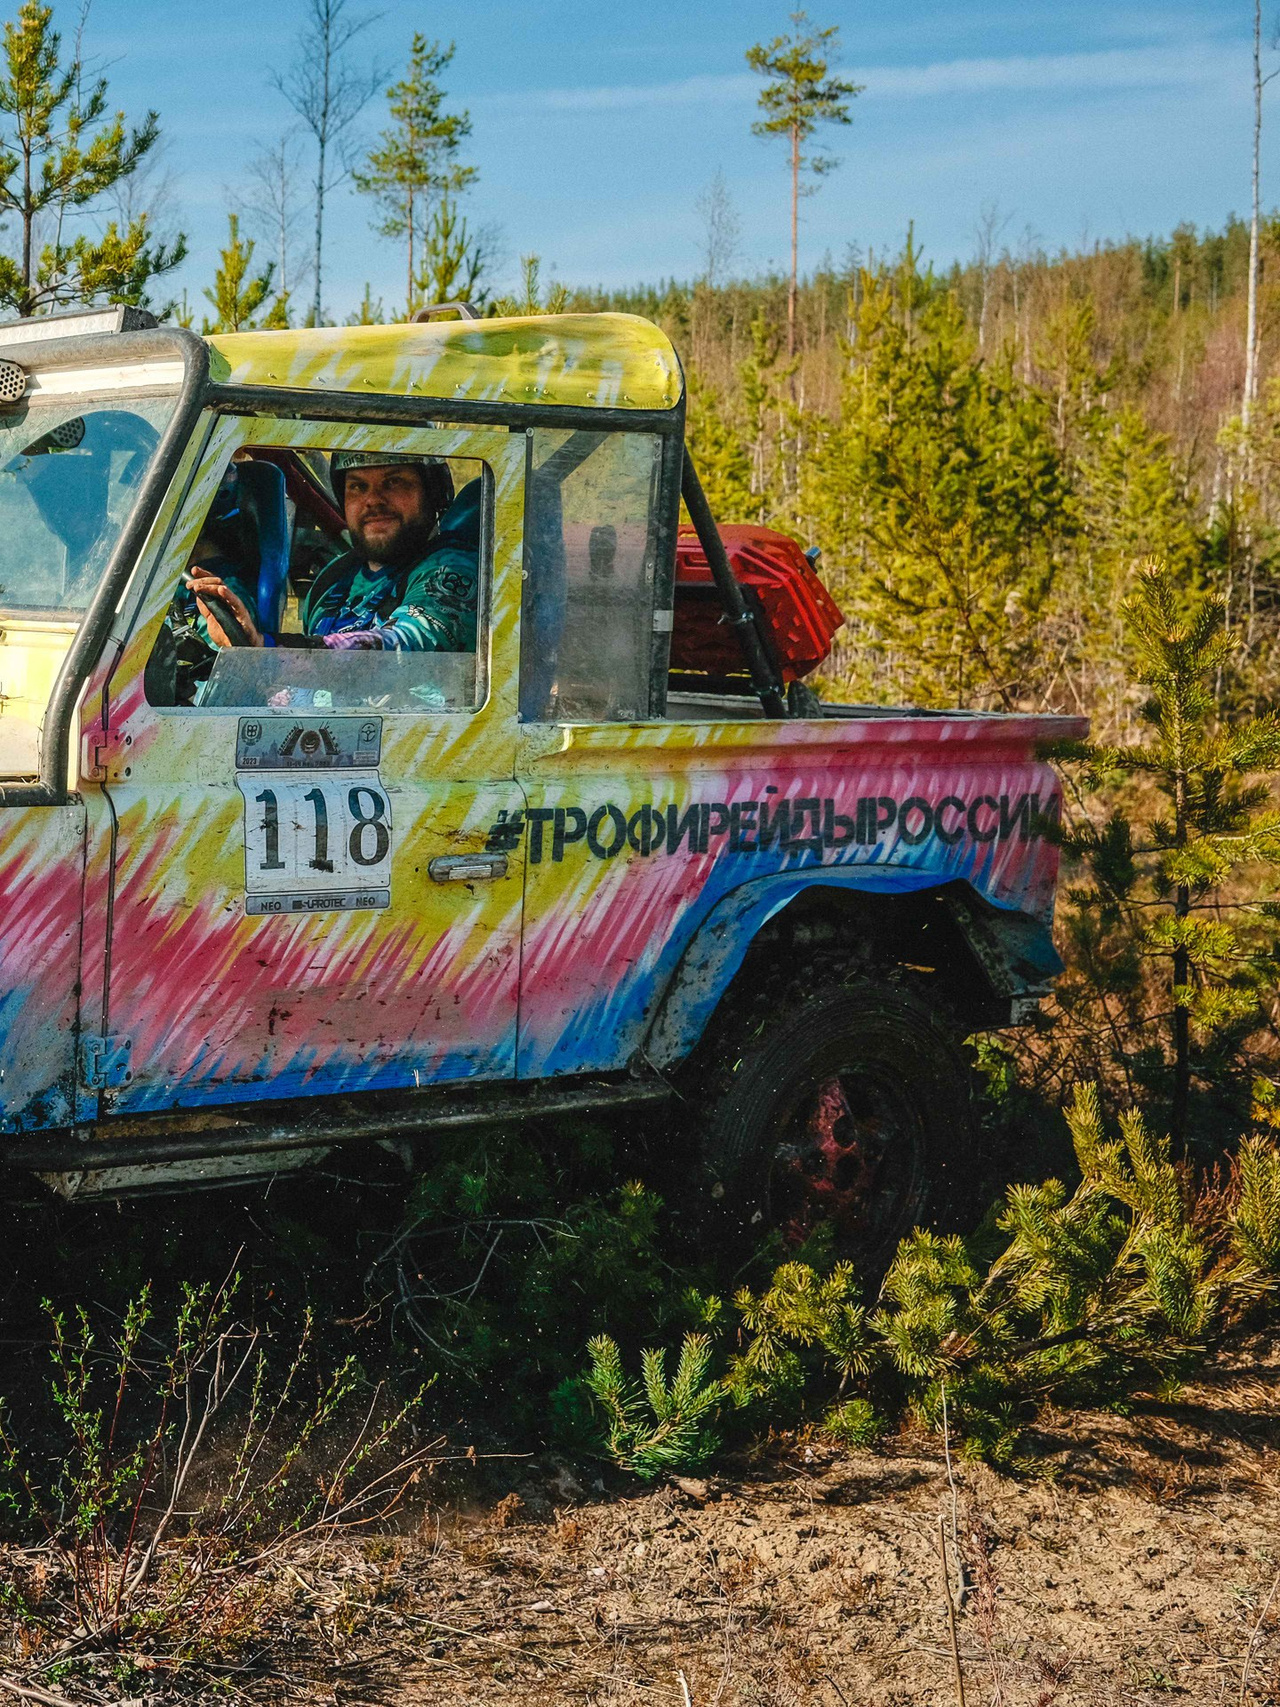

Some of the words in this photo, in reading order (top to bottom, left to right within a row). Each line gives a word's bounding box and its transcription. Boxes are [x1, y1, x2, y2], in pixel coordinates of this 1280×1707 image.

[242, 757, 257, 765] 2023
[255, 786, 389, 873] 118
[260, 901, 282, 911] NEO
[301, 897, 346, 909] SUPROTEC
[355, 896, 376, 907] NEO
